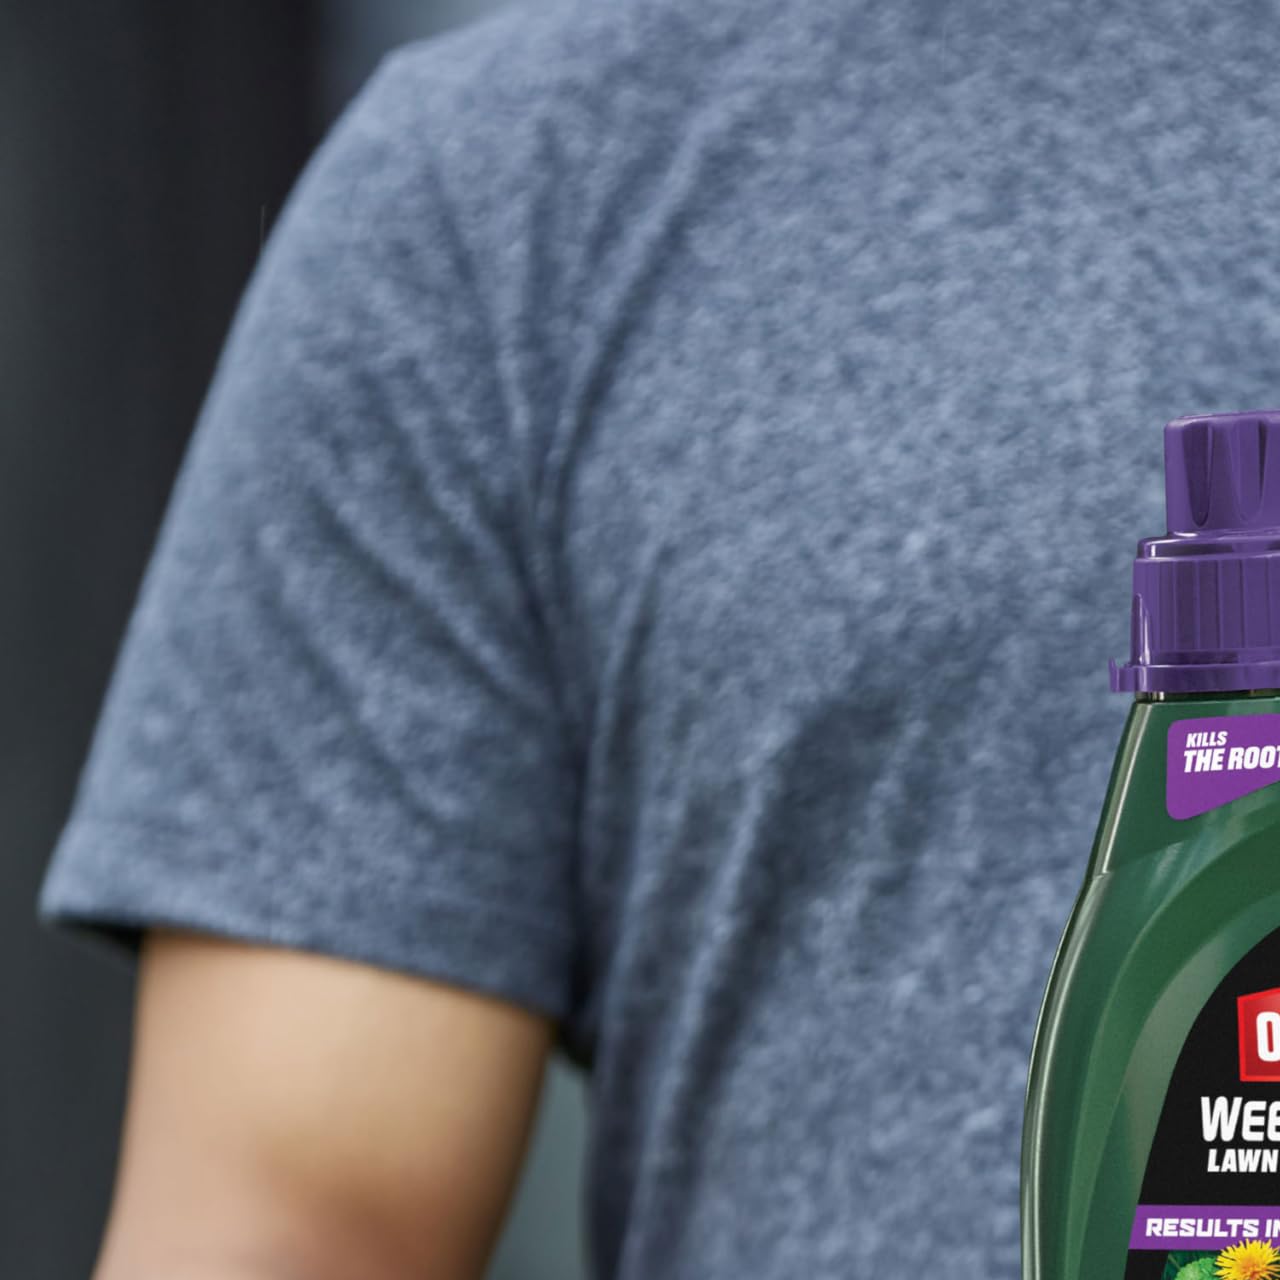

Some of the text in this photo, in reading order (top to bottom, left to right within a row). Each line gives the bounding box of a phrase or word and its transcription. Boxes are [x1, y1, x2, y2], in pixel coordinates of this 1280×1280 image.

[1186, 731, 1228, 747] KILLS
[1184, 747, 1225, 773] THE
[1207, 1148, 1278, 1172] LAWN
[1145, 1218, 1259, 1238] RESULTS
